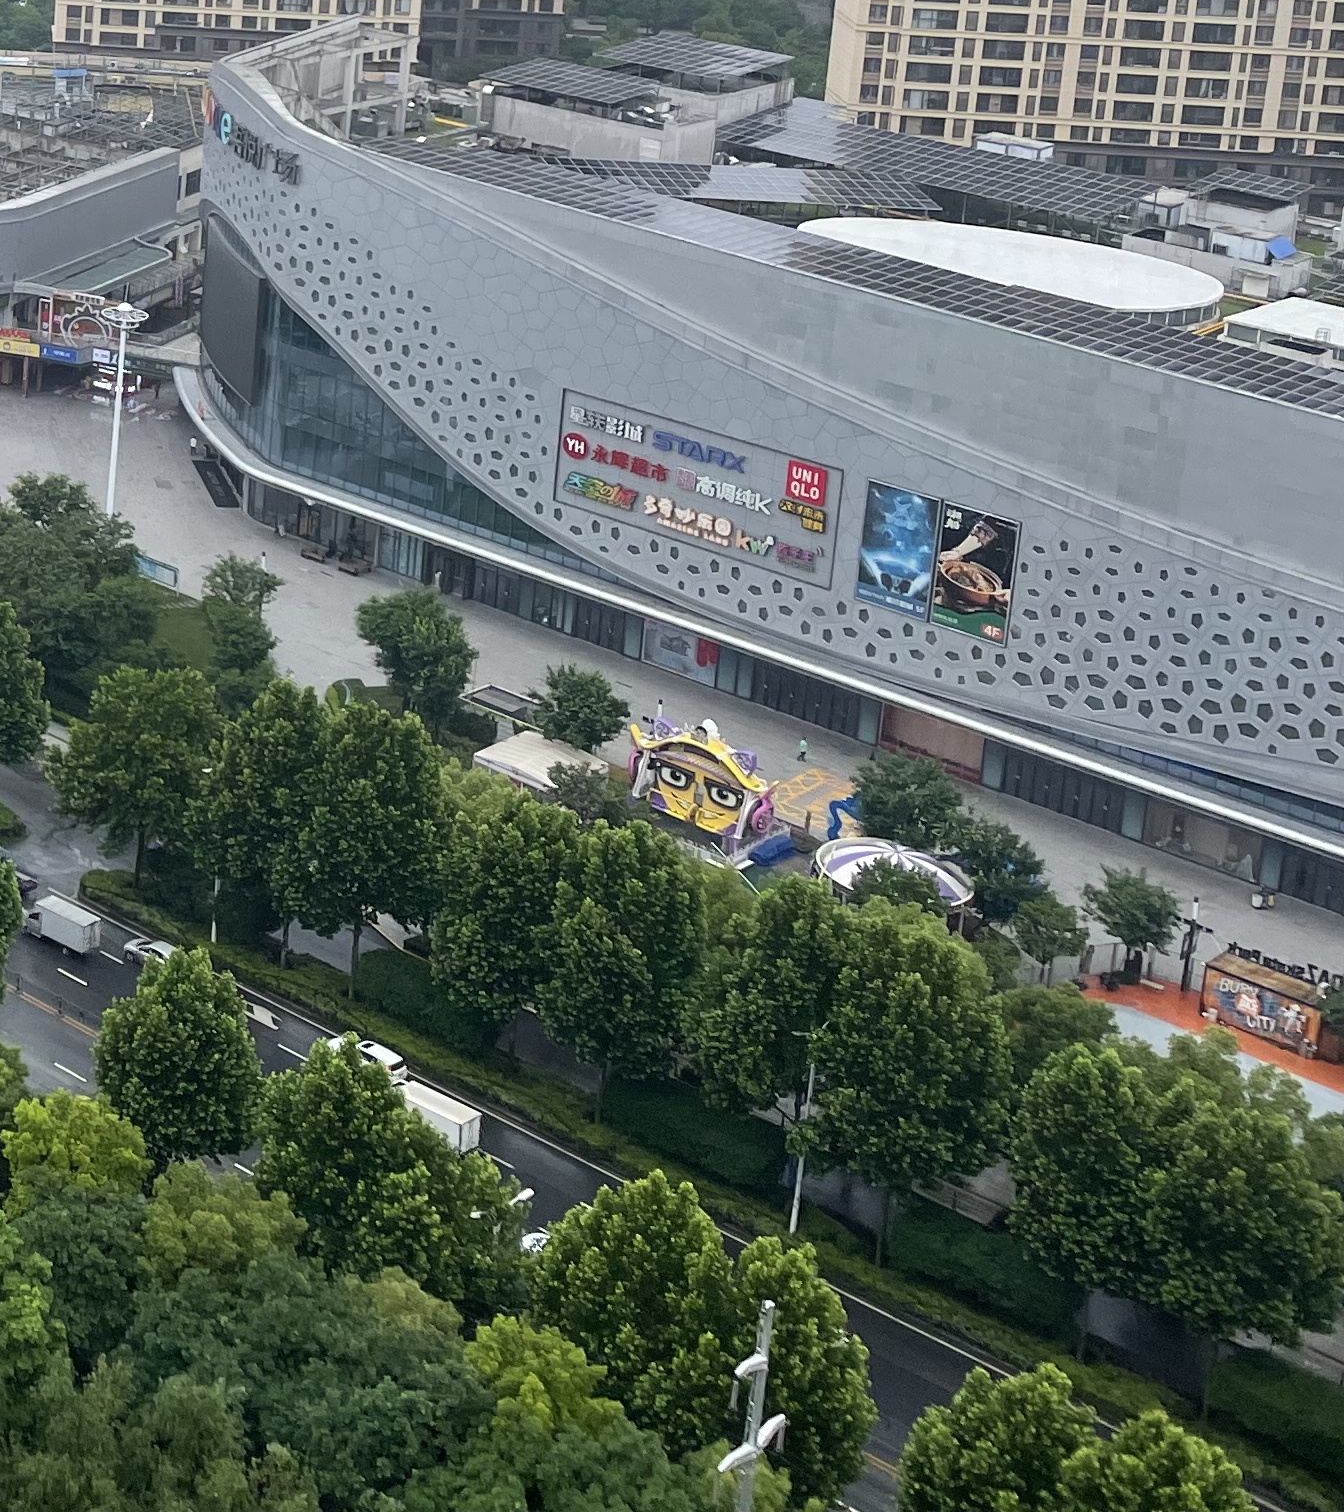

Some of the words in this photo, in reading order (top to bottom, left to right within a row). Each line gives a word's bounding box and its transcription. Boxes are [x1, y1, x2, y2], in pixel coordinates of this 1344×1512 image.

[566, 437, 586, 455] YH
[652, 430, 746, 474] STARX
[792, 465, 819, 485] UNI
[790, 482, 820, 500] QLO
[984, 625, 1002, 638] 4F
